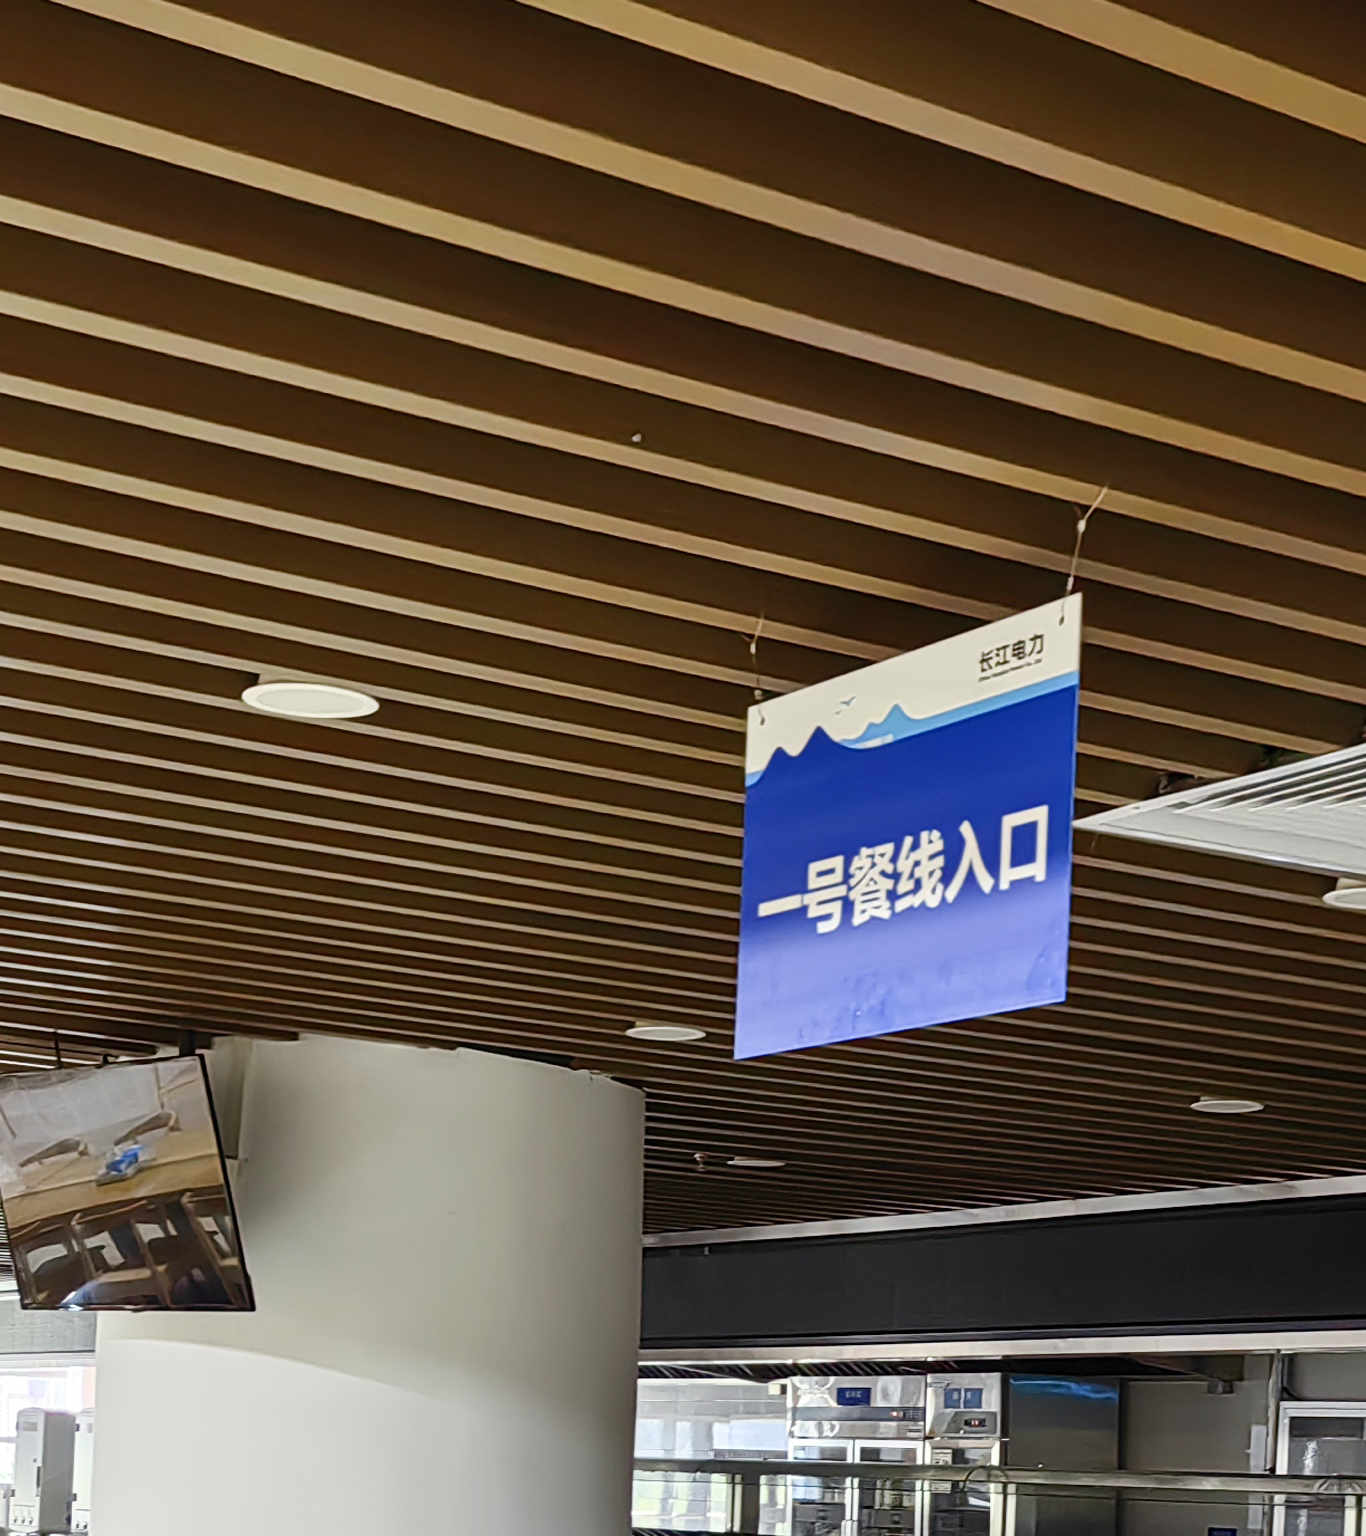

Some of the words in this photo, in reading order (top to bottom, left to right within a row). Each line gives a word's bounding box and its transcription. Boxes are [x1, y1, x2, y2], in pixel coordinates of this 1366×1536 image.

[979, 634, 1044, 672] 长江电力
[757, 805, 1049, 934] 一号餐线入口
